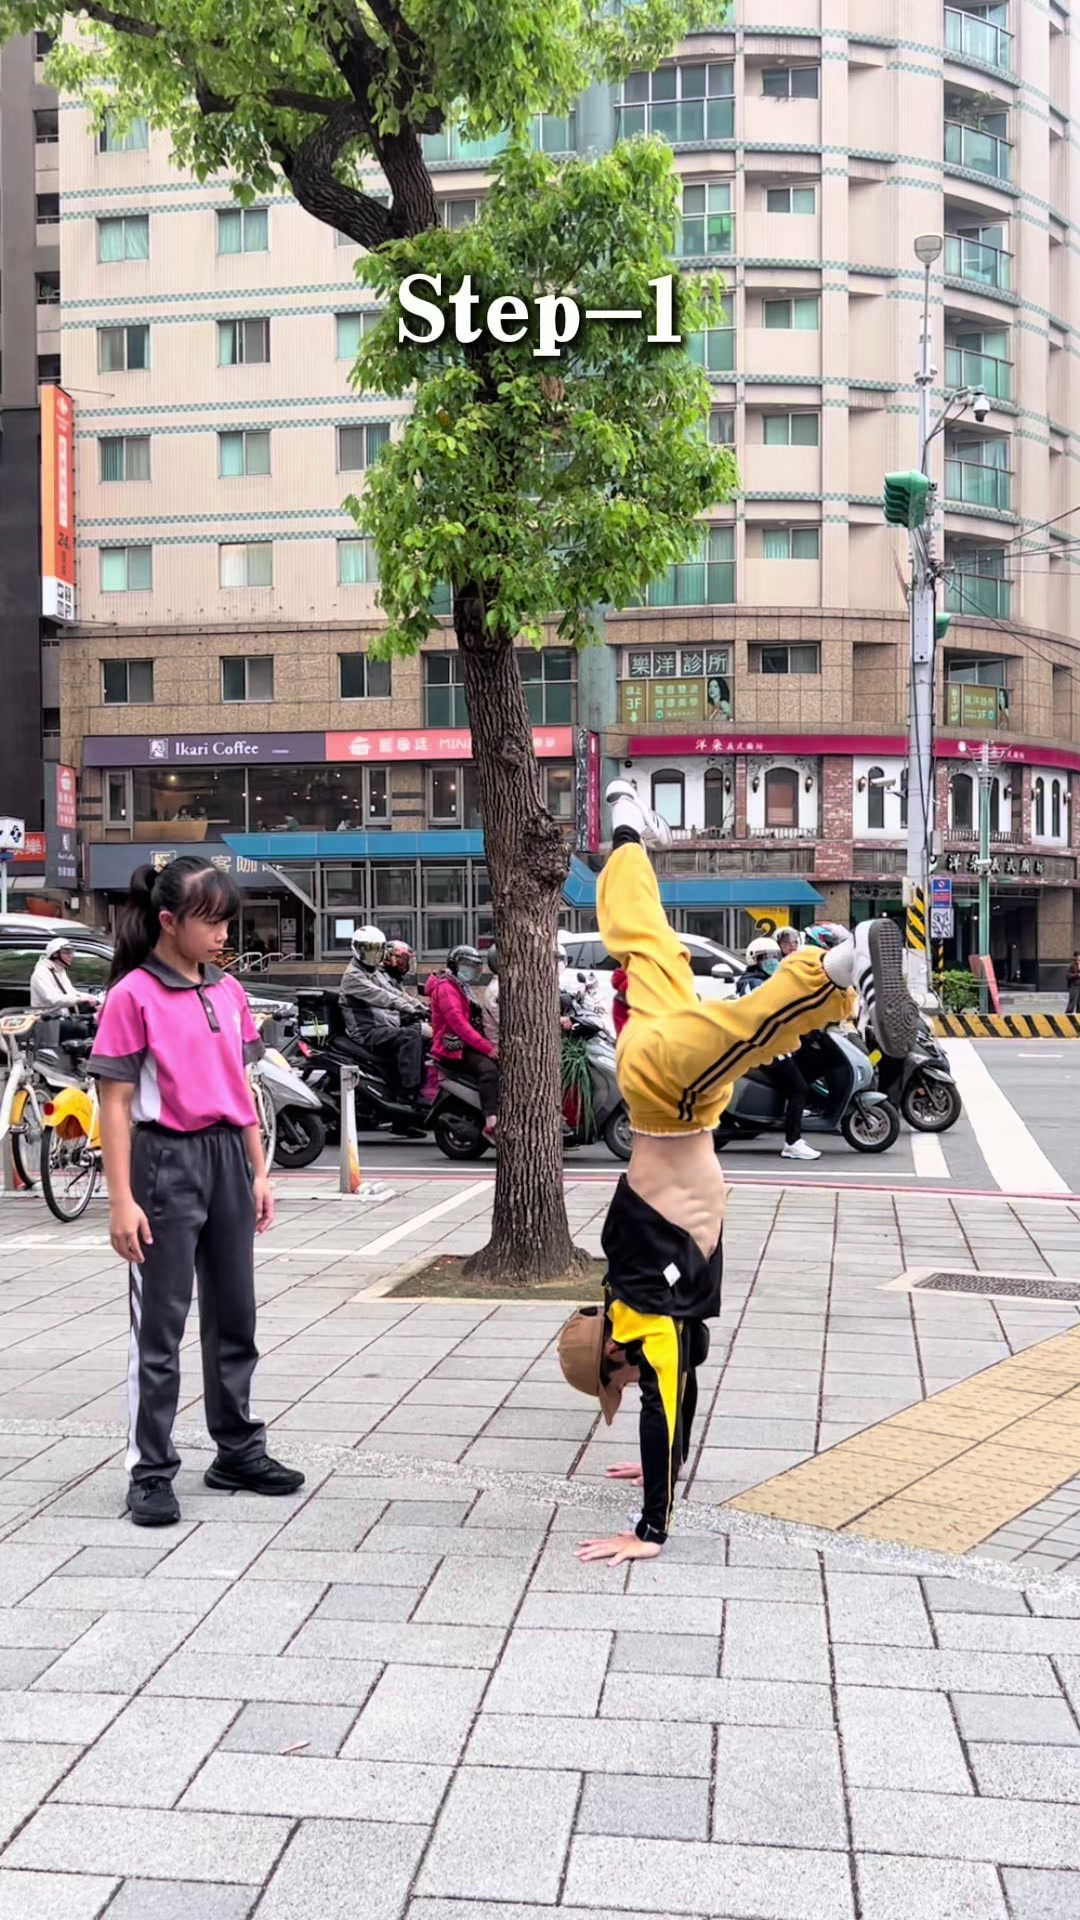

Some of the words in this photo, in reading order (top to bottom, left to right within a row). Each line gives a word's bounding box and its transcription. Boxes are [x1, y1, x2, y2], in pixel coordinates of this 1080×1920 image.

[631, 653, 727, 675] 樂洋診所
[626, 698, 642, 710] 3F
[175, 742, 209, 756] Ikari
[212, 740, 260, 755] Coffee
[211, 855, 284, 874] 客咖
